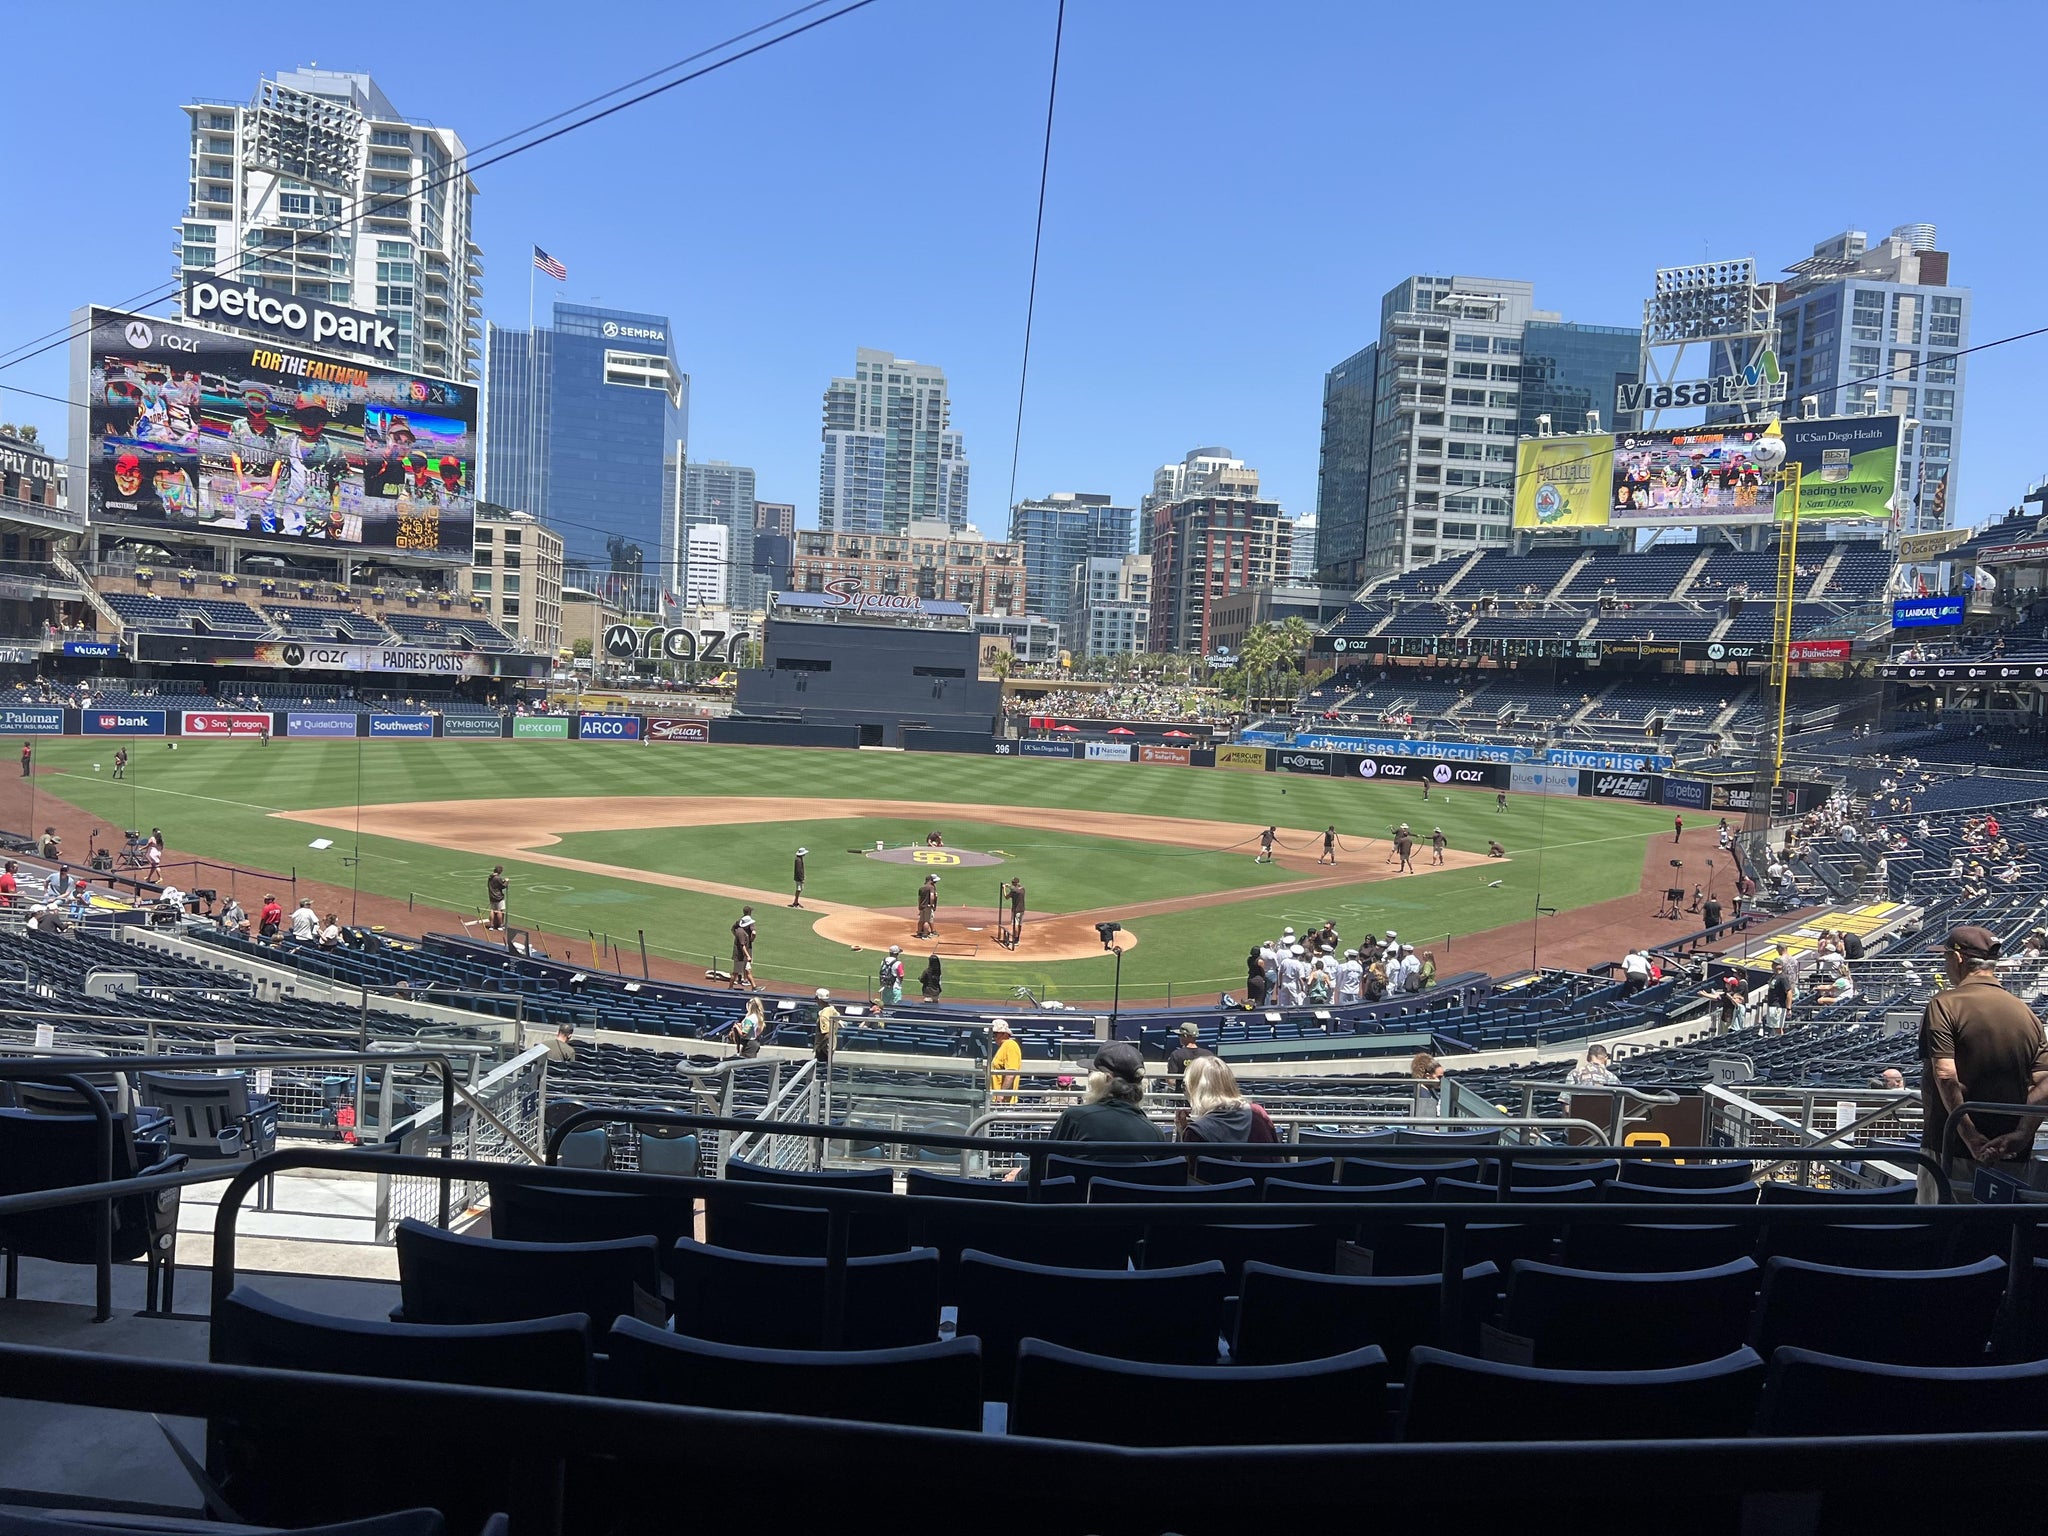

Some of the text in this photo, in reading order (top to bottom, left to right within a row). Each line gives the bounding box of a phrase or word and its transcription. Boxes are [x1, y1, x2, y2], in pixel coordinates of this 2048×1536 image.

[192, 280, 397, 352] petco park
[620, 326, 665, 341] SEMPRA
[159, 334, 200, 354] razr
[1622, 376, 1730, 411] Viasat
[1795, 429, 1883, 443] UC San Diego Health
[1824, 450, 1848, 459] BEST
[32, 457, 53, 481] CO.
[1800, 484, 1884, 497] eading the Way
[1805, 500, 1824, 509] San
[1827, 499, 1854, 509] Diego
[823, 577, 924, 616] Sycuan
[1905, 607, 1937, 619] LANDCARE
[642, 625, 750, 663] razr
[1348, 640, 1368, 649] razr
[86, 646, 108, 656] USAA
[1728, 647, 1754, 657] razr
[1801, 648, 1841, 658] Budweiser
[309, 650, 463, 671] razr PADRES POSTS
[6, 712, 59, 724] Palomar
[100, 715, 148, 726] us bank
[445, 720, 500, 728] CYMBIOTIKA
[211, 719, 263, 730] Snadragon
[304, 720, 353, 730] QuidelOrtho
[374, 720, 423, 731] Southwest
[582, 721, 622, 735] ARCO
[652, 720, 702, 739] Sycuan
[995, 744, 1009, 754] 396
[1041, 745, 1053, 753] Diego
[1417, 744, 1509, 763] citycruises
[1283, 755, 1324, 767] EVOTEK
[1381, 763, 1407, 776] razr
[1455, 769, 1484, 782] razr
[1512, 772, 1533, 783] blue
[1546, 774, 1567, 785] blue
[1613, 789, 1646, 798] POWER
[1675, 782, 1701, 799] petco
[1730, 790, 1750, 800] SLAP
[104, 983, 124, 994] 104
[1899, 1020, 1917, 1031] 103
[1721, 1068, 1735, 1080] 101
[1719, 1137, 1725, 1147] G
[1988, 1183, 1999, 1199] F
